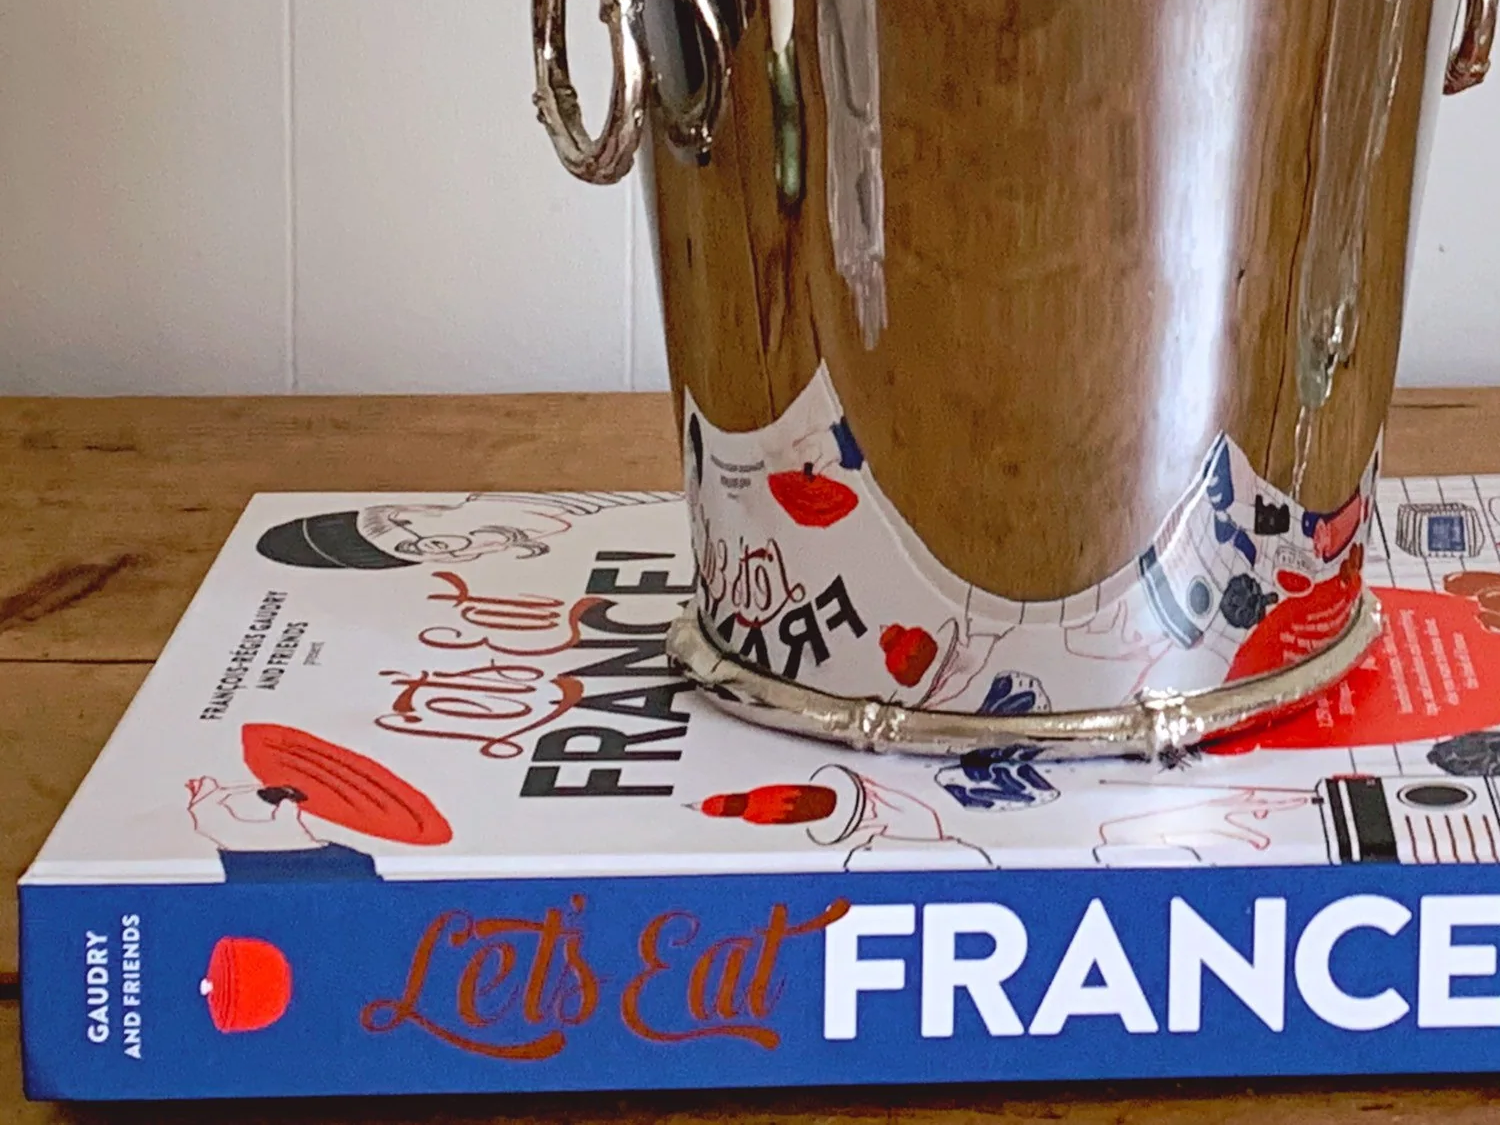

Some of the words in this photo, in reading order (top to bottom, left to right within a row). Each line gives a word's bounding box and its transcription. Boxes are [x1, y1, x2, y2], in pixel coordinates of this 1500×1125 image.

[200, 634, 266, 720] FRANÇOIS-RÉGIS
[250, 591, 288, 631] GAUDRY
[267, 622, 308, 665] FRIENDS
[419, 571, 602, 656] Eat
[255, 668, 285, 690] AND
[374, 658, 584, 759] Let's
[86, 930, 109, 1043] GAUDRY
[121, 913, 141, 1006] FRIENDS
[359, 893, 602, 1061] Let's
[620, 896, 851, 1052] Eat
[123, 1011, 142, 1059] AND
